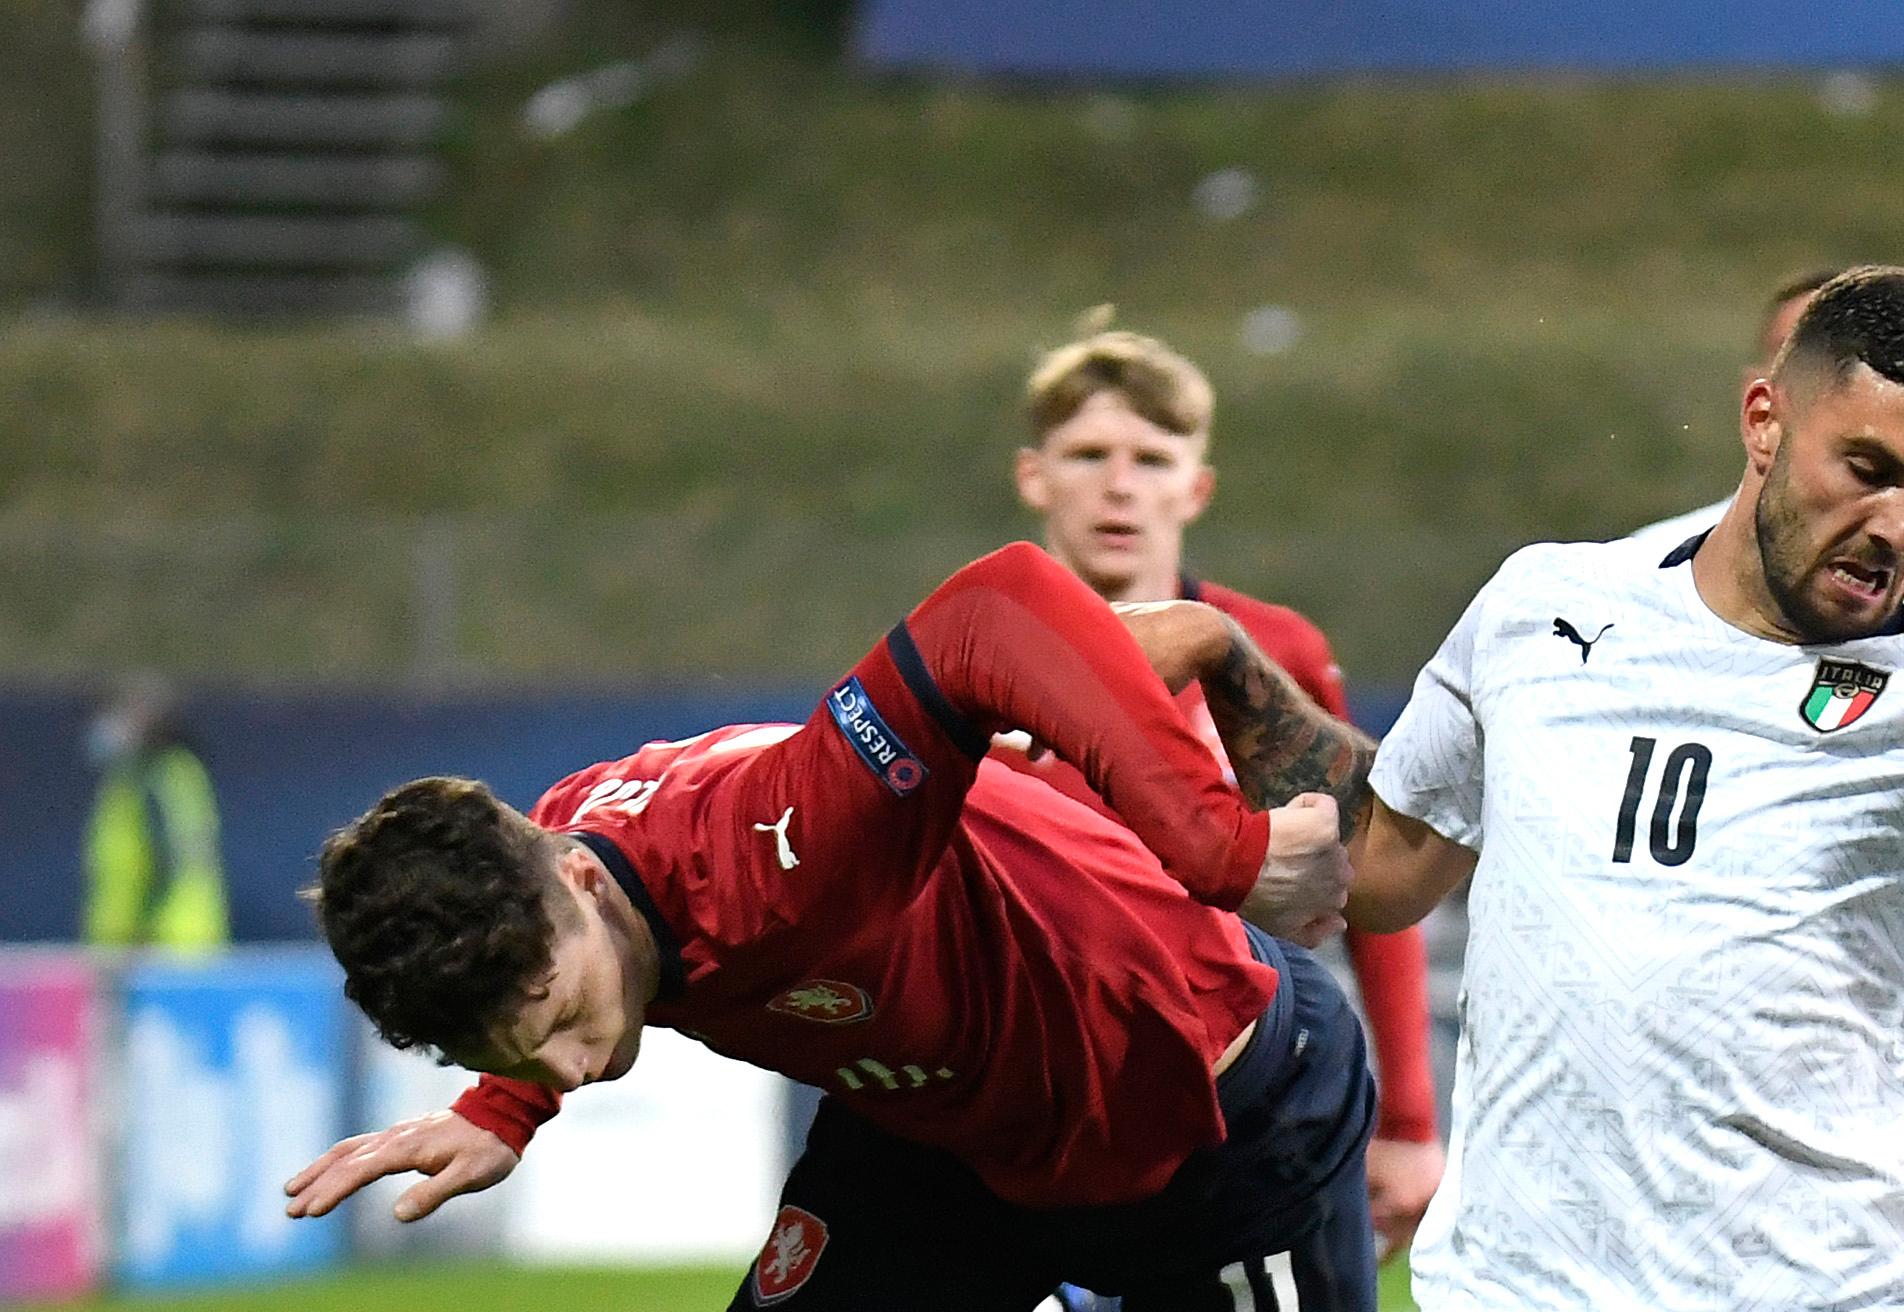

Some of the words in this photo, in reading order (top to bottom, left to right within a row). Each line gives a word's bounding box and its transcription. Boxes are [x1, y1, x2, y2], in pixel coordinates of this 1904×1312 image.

[1821, 666, 1883, 689] ITALIA
[834, 685, 897, 765] RESPECT
[1612, 736, 1713, 867] 10
